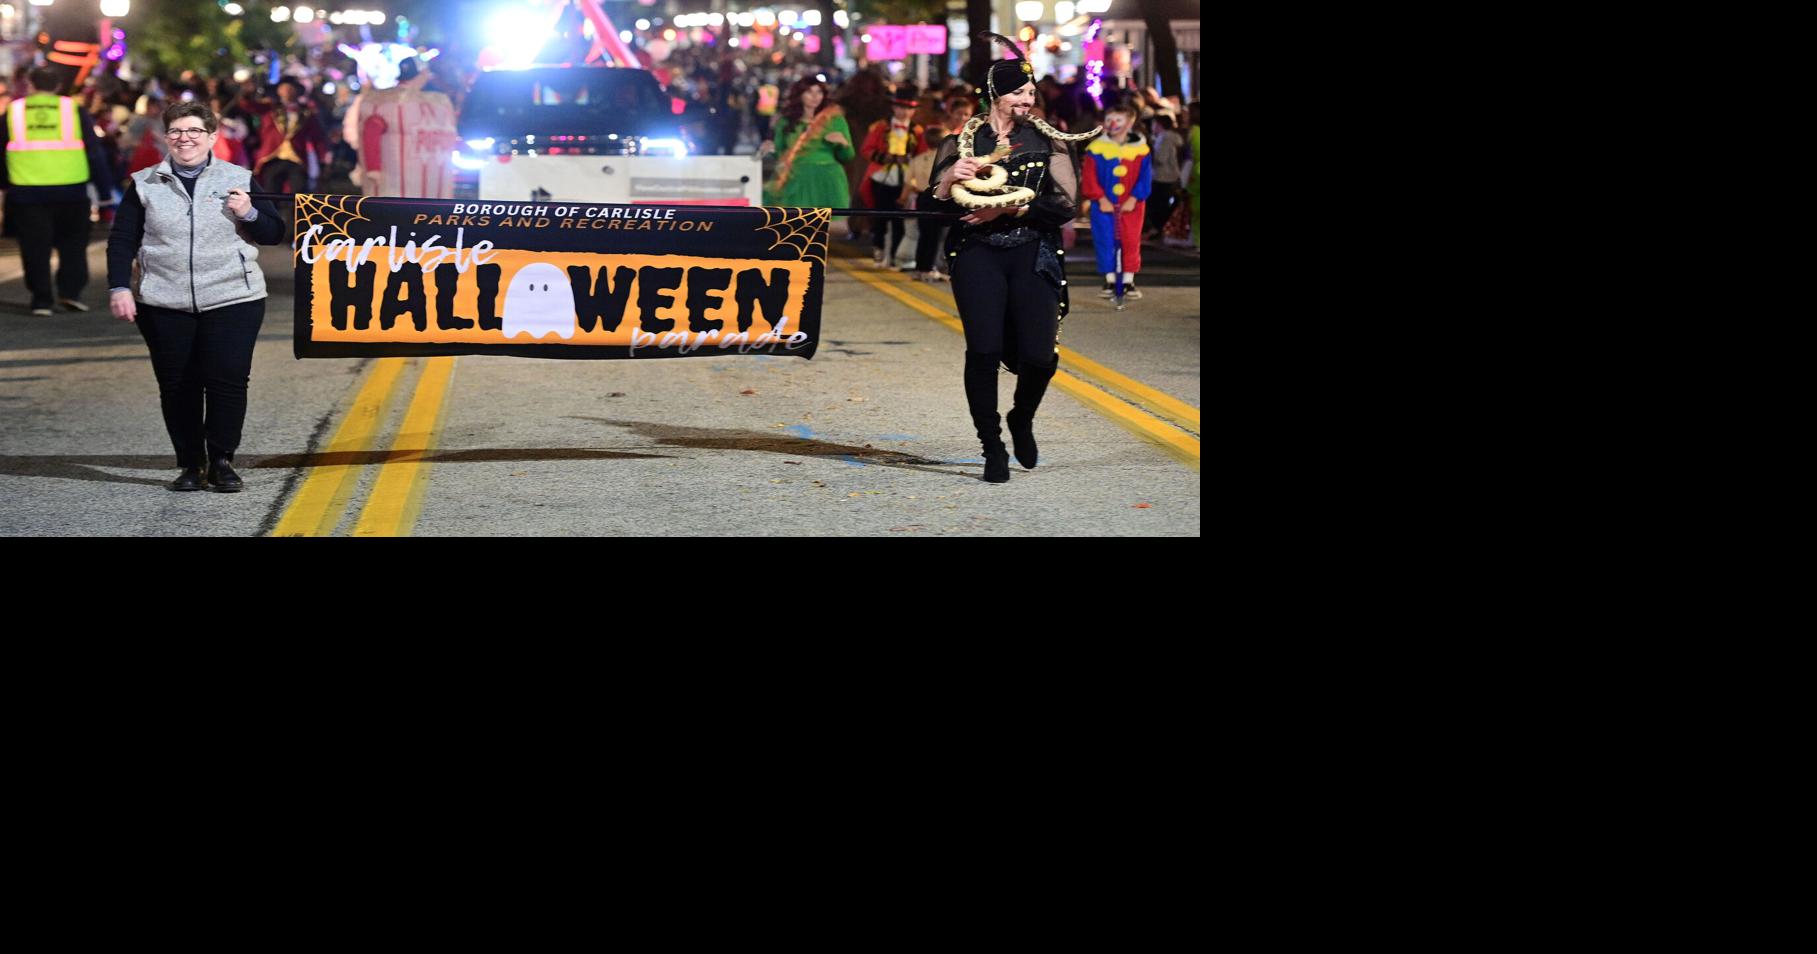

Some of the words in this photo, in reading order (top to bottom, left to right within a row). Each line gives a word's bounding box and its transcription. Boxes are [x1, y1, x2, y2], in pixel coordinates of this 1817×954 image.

[413, 213, 491, 227] PARKS
[498, 217, 550, 228] AND
[559, 218, 713, 232] RECREATION
[453, 203, 548, 217] BOROUGH
[554, 206, 580, 217] OF
[585, 207, 676, 220] CARLISLE
[301, 224, 499, 274] Carlisle
[329, 260, 791, 339] HALLWEEN
[629, 316, 812, 357] parade
